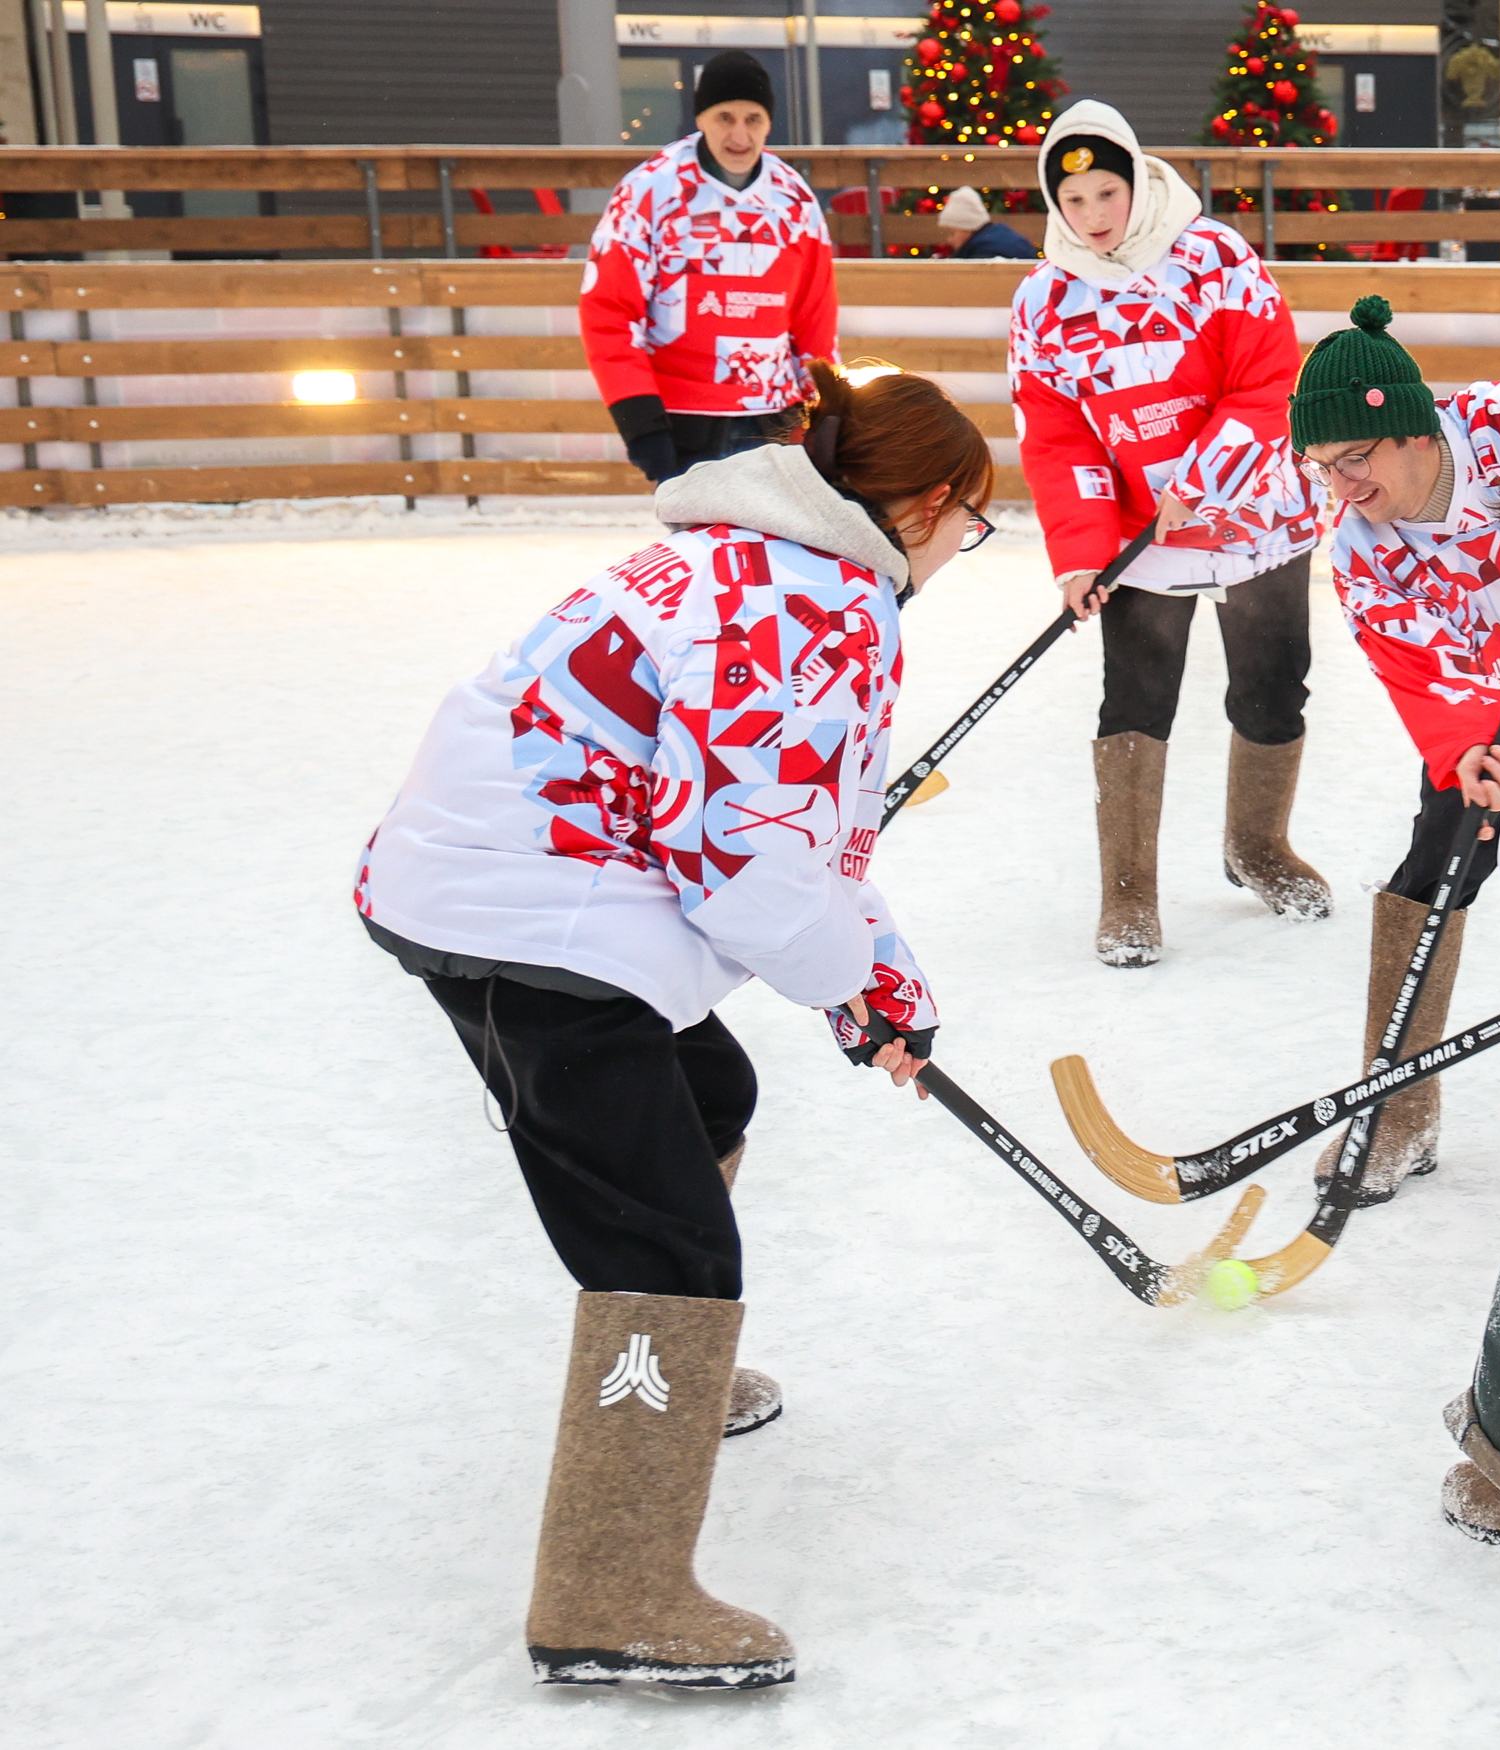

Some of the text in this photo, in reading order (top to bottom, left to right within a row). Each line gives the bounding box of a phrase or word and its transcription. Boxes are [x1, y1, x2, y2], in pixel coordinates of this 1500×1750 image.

[188, 11, 227, 31] WC
[627, 22, 661, 40] WC
[1138, 415, 1180, 441] СПОРТ
[930, 717, 973, 761] ORANGE
[969, 692, 997, 720] HAIL
[1381, 973, 1420, 1050] ORANGE
[1410, 930, 1437, 972] HAIL
[1230, 1115, 1299, 1166] STEX
[1343, 1061, 1417, 1107] ORANGE
[1418, 1041, 1462, 1071] HAIL
[1018, 1156, 1144, 1273] ORANGE HAIL STEX
